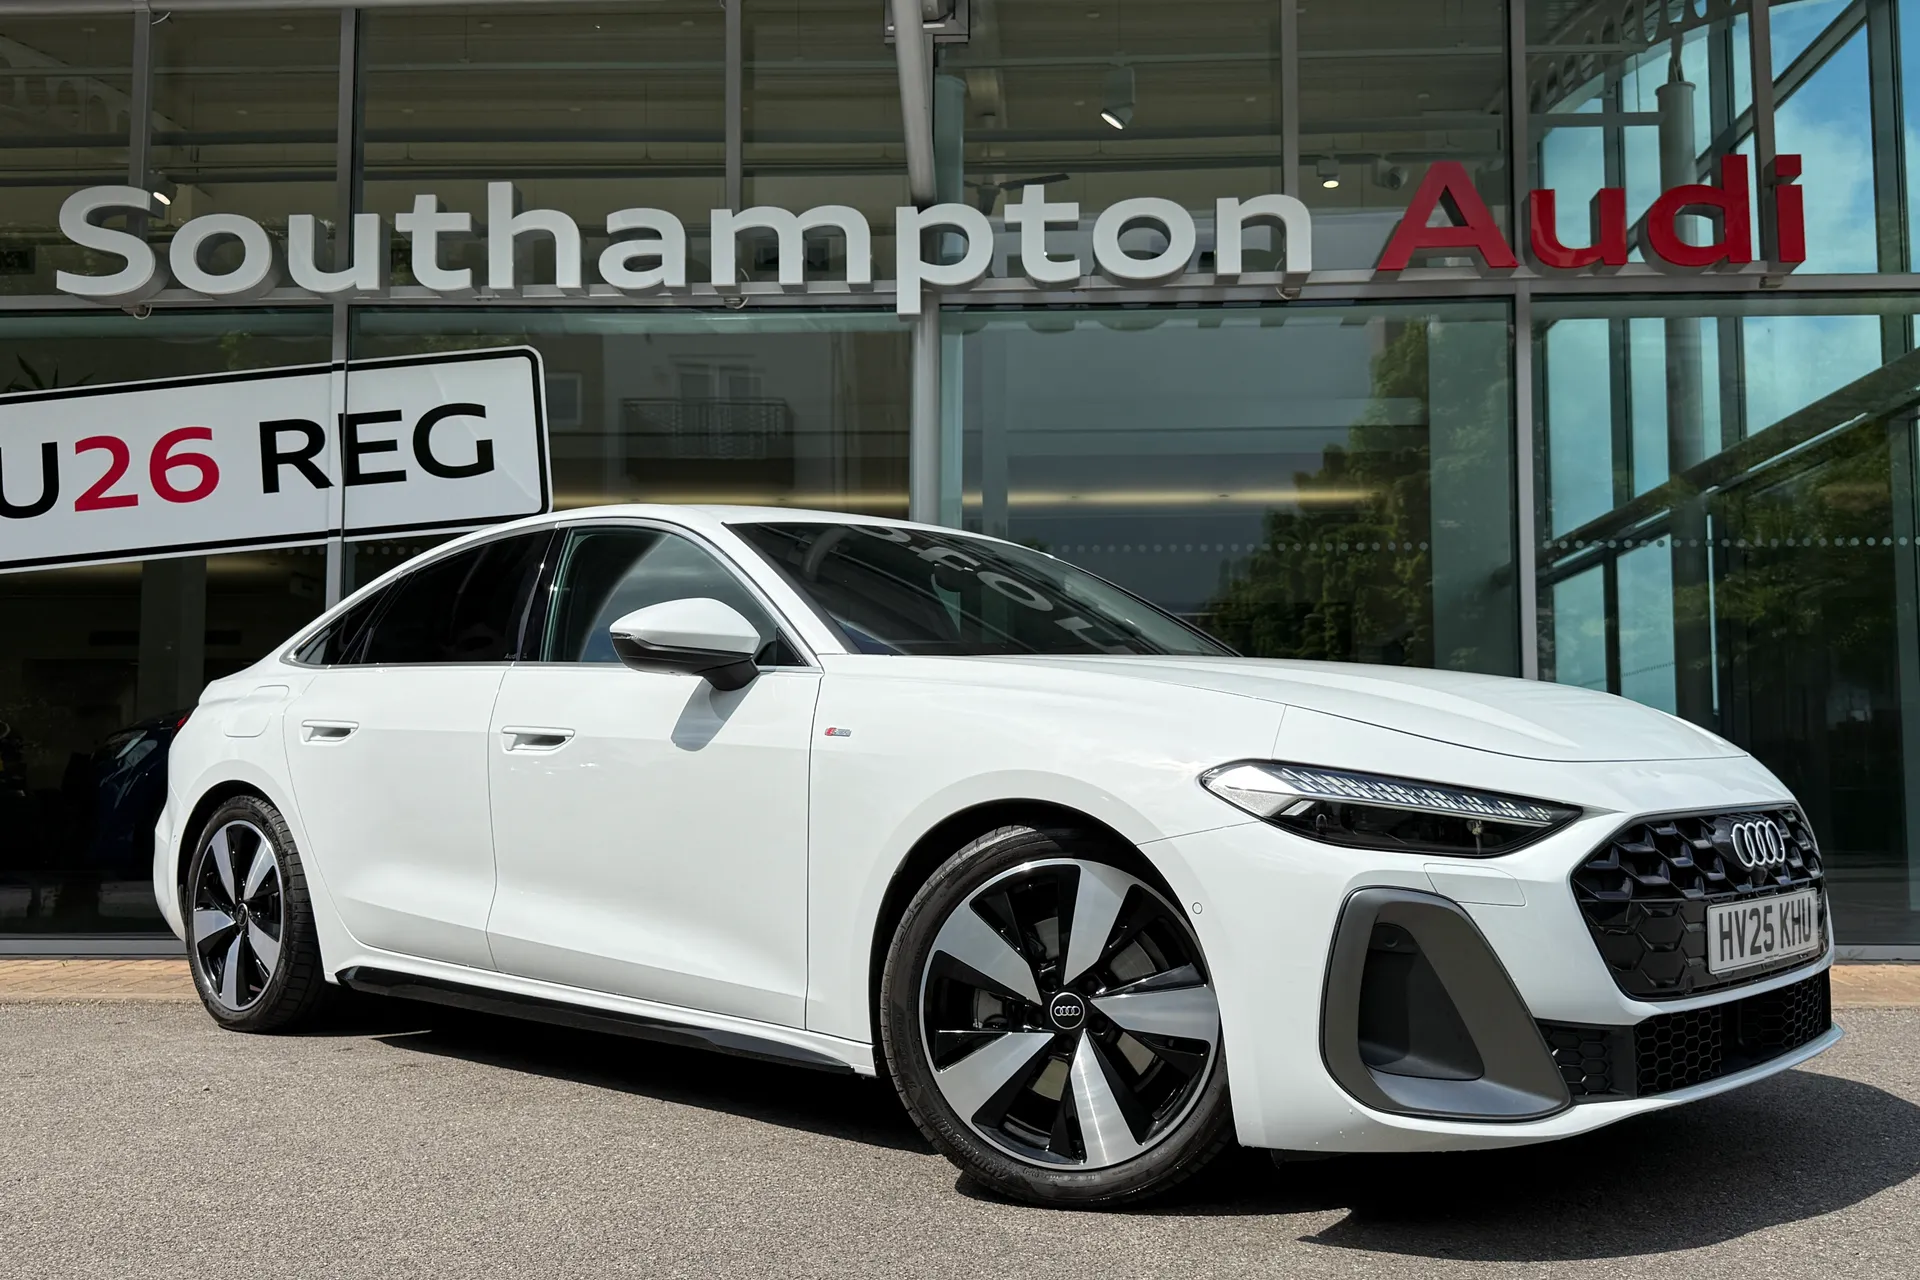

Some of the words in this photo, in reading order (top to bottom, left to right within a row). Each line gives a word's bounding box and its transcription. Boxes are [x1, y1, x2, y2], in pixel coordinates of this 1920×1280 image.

[56, 182, 1312, 315] Southampton
[1377, 154, 1805, 272] Audi
[259, 402, 495, 494] REG
[1719, 905, 1775, 961] HV25
[1780, 897, 1811, 949] KHU
